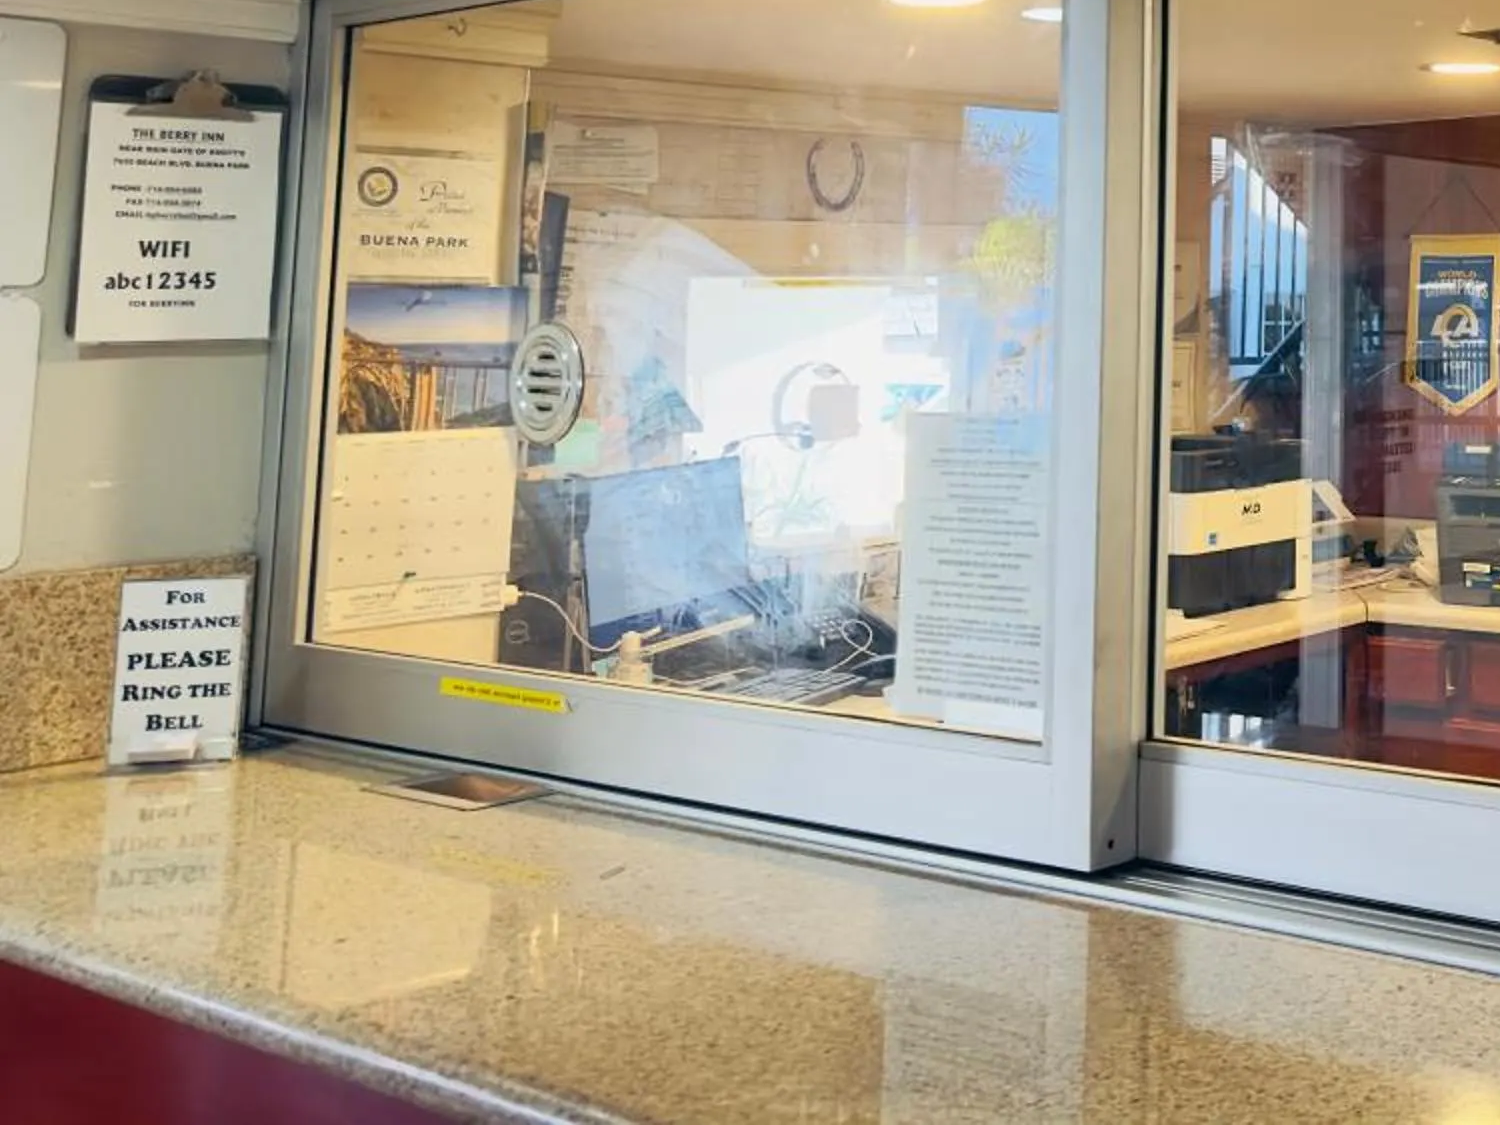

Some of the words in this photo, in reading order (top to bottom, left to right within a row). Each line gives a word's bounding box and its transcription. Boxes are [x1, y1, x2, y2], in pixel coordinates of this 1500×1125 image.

[132, 128, 154, 141] THE
[159, 130, 198, 142] BERRY
[202, 132, 225, 142] INN
[139, 240, 190, 258] WIFI
[360, 234, 419, 246] BUENA
[426, 236, 469, 248] PARK
[105, 271, 217, 290] abc12345
[122, 616, 241, 632] ASSISTANCE
[127, 649, 232, 670] PLEASE
[121, 684, 182, 702] RING
[187, 682, 231, 698] THE
[145, 714, 204, 732] BELL
